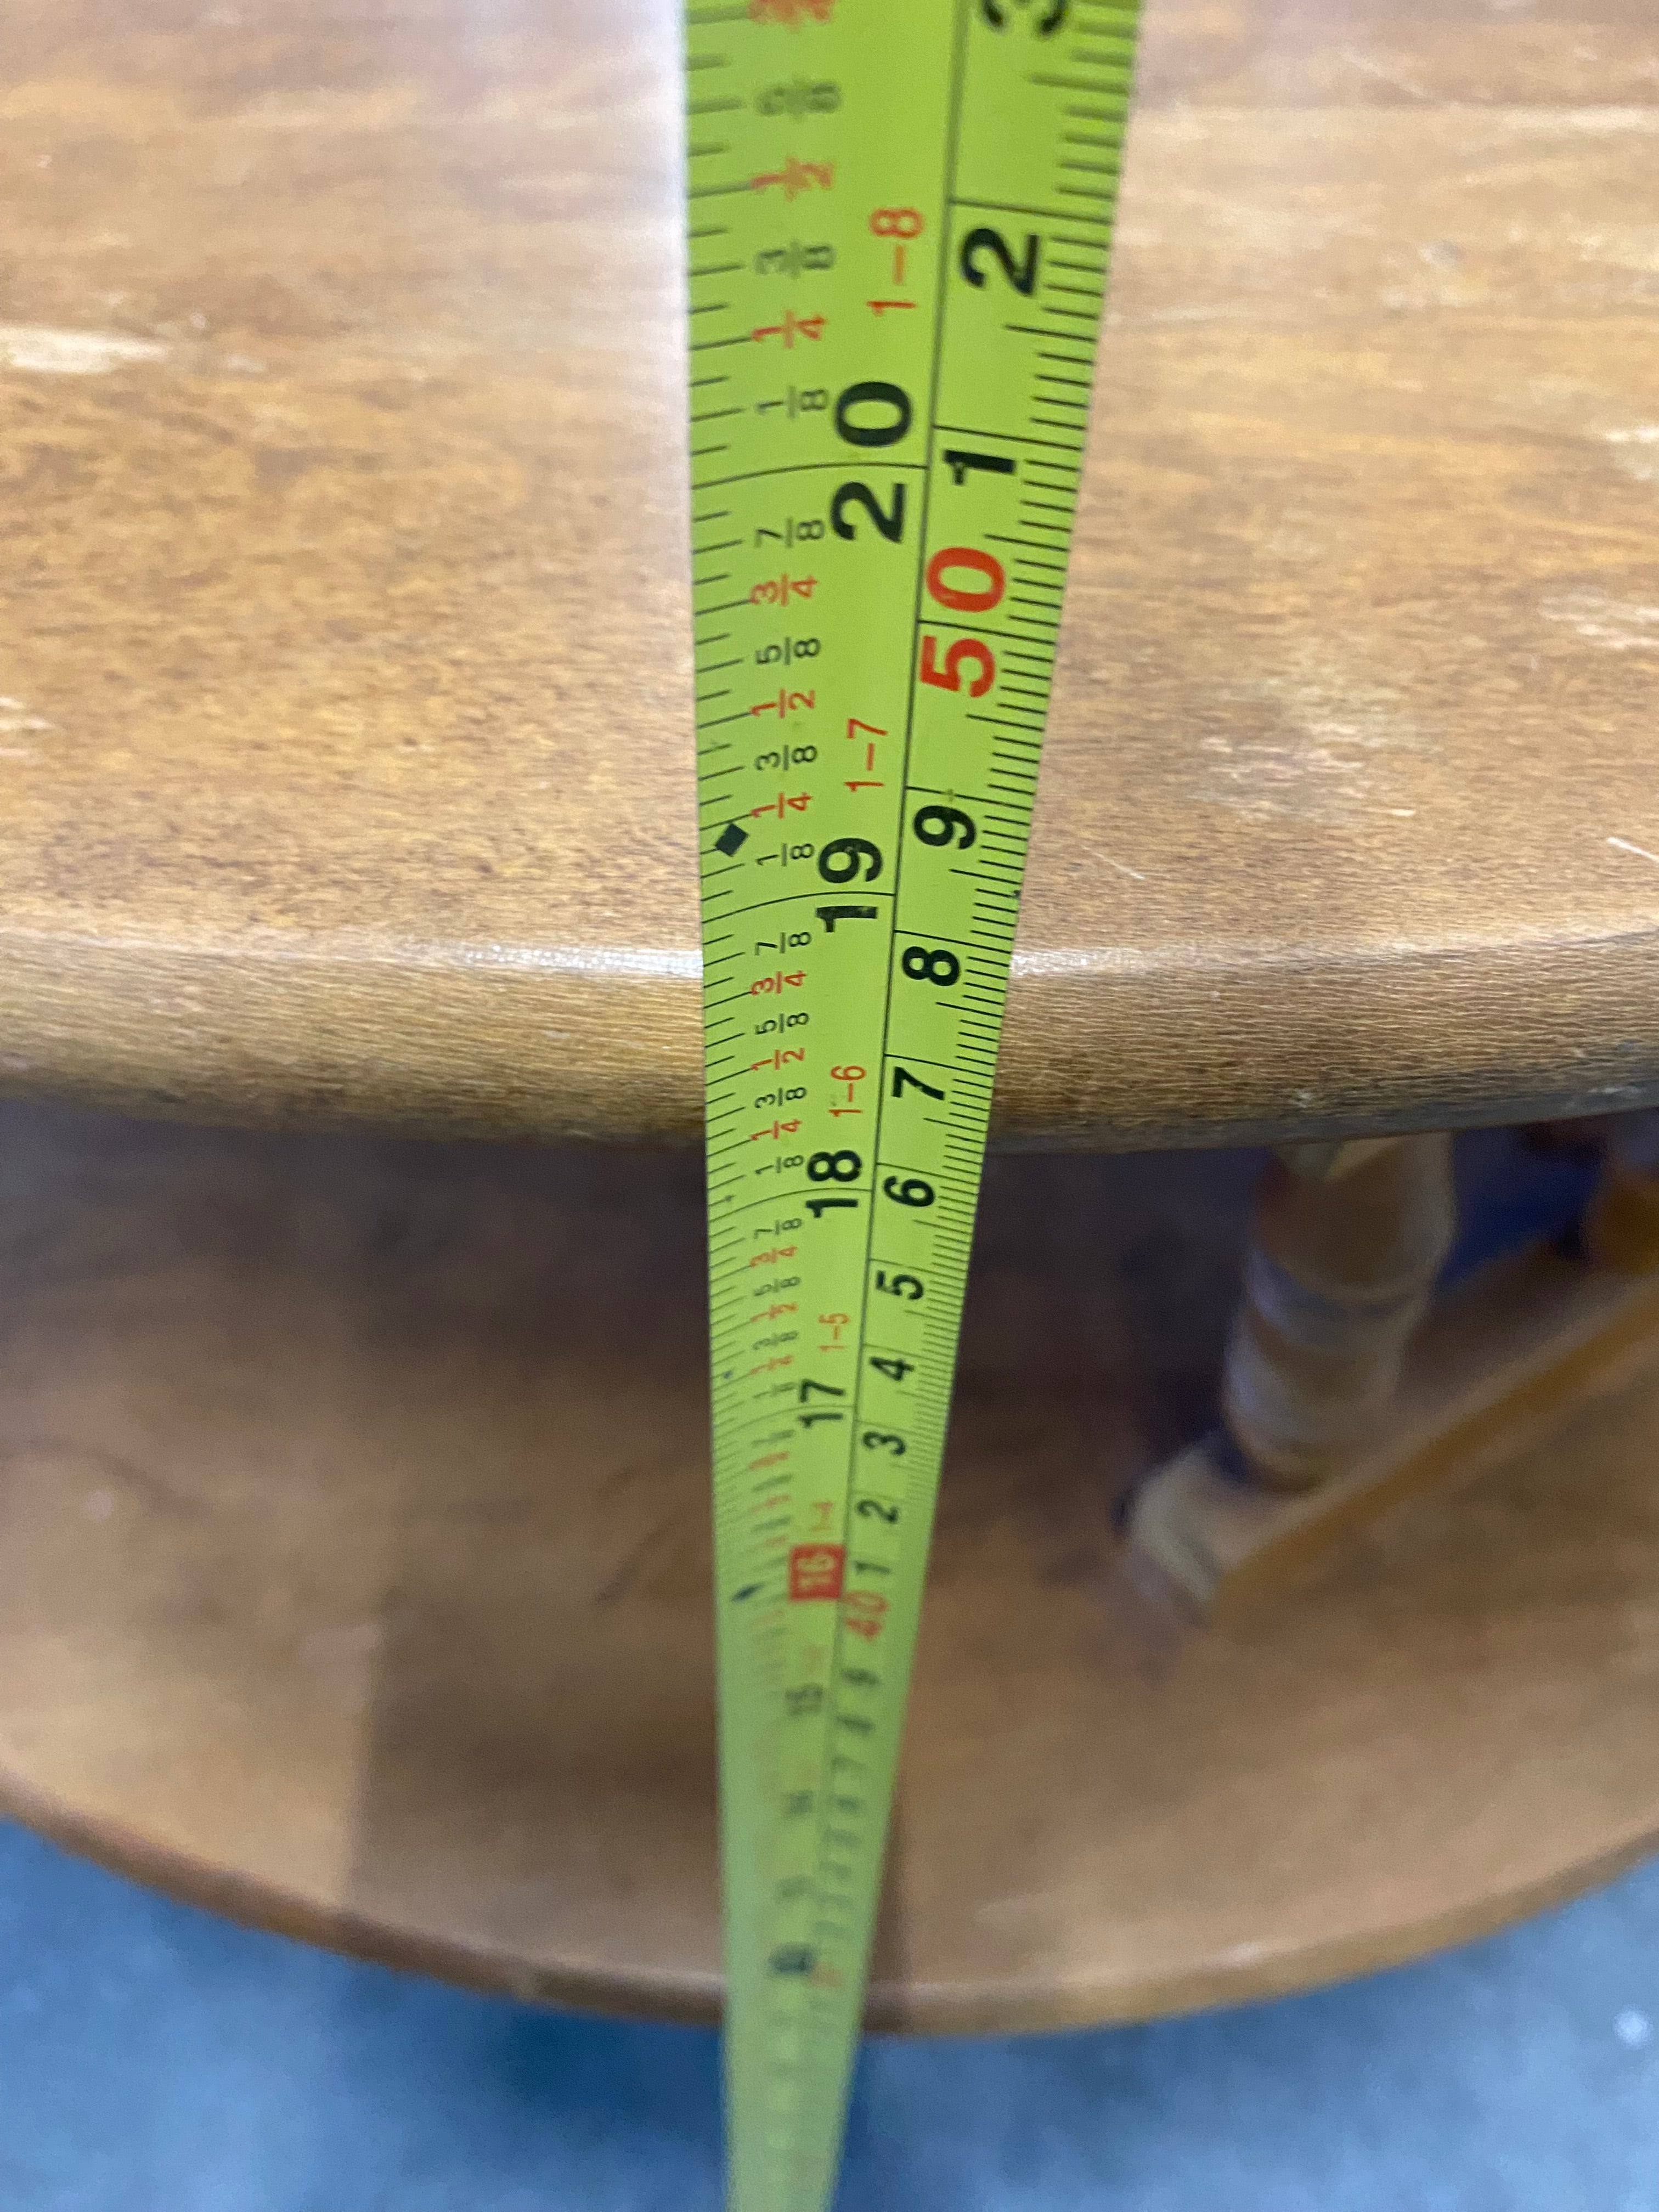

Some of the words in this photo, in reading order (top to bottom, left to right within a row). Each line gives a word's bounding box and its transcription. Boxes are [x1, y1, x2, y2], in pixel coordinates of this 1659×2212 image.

[961, 228, 1040, 295] 2
[830, 381, 912, 543] 20
[944, 450, 1017, 486] 1
[919, 547, 1006, 697] 50
[912, 805, 976, 849] 9
[815, 838, 883, 933] 19
[902, 946, 960, 986] 8
[891, 1066, 945, 1100] 7
[805, 1150, 861, 1218] 18
[884, 1176, 935, 1207] 6
[876, 1271, 923, 1300] 5
[870, 1357, 915, 1381] 4
[799, 1379, 845, 1429] 17
[863, 1432, 906, 1455] 3
[856, 1499, 899, 1523] 2
[855, 1560, 890, 1575] 1
